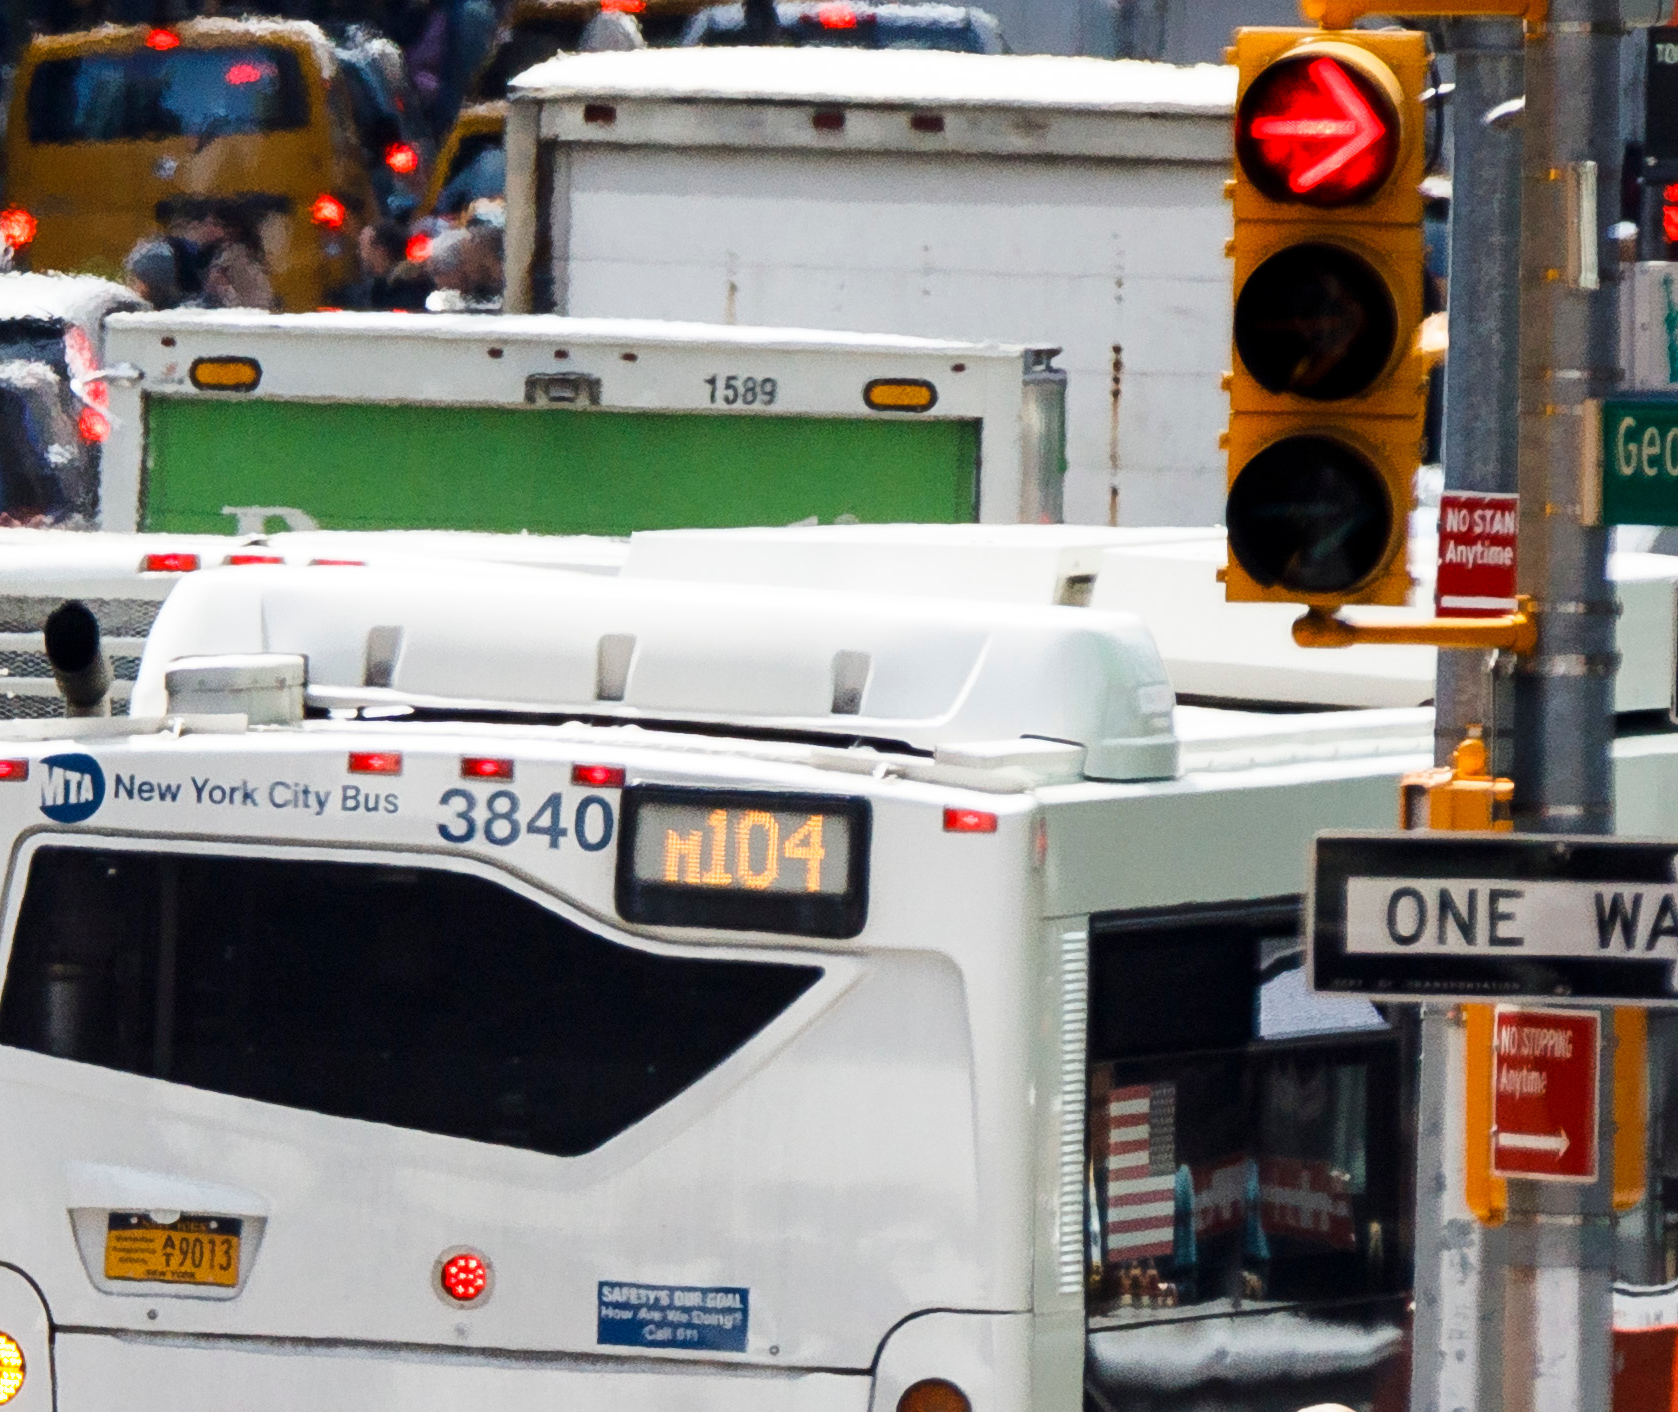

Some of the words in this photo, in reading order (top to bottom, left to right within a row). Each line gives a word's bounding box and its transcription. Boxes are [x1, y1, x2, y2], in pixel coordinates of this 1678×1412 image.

[703, 374, 779, 406] 1589
[1446, 509, 1471, 533] NO
[1445, 540, 1514, 569] Anytime
[39, 762, 95, 807] MTA
[112, 773, 181, 804] New
[191, 775, 260, 808] York
[268, 780, 332, 816] City
[341, 783, 400, 816] Bus
[437, 786, 614, 853] 3840
[1384, 886, 1525, 947] ONE
[1500, 1024, 1518, 1057] NO
[1520, 1026, 1574, 1060] STOPPING
[1499, 1063, 1548, 1100] Anytime
[178, 1236, 234, 1272] 9013
[601, 1286, 671, 1307] SAFETY'S
